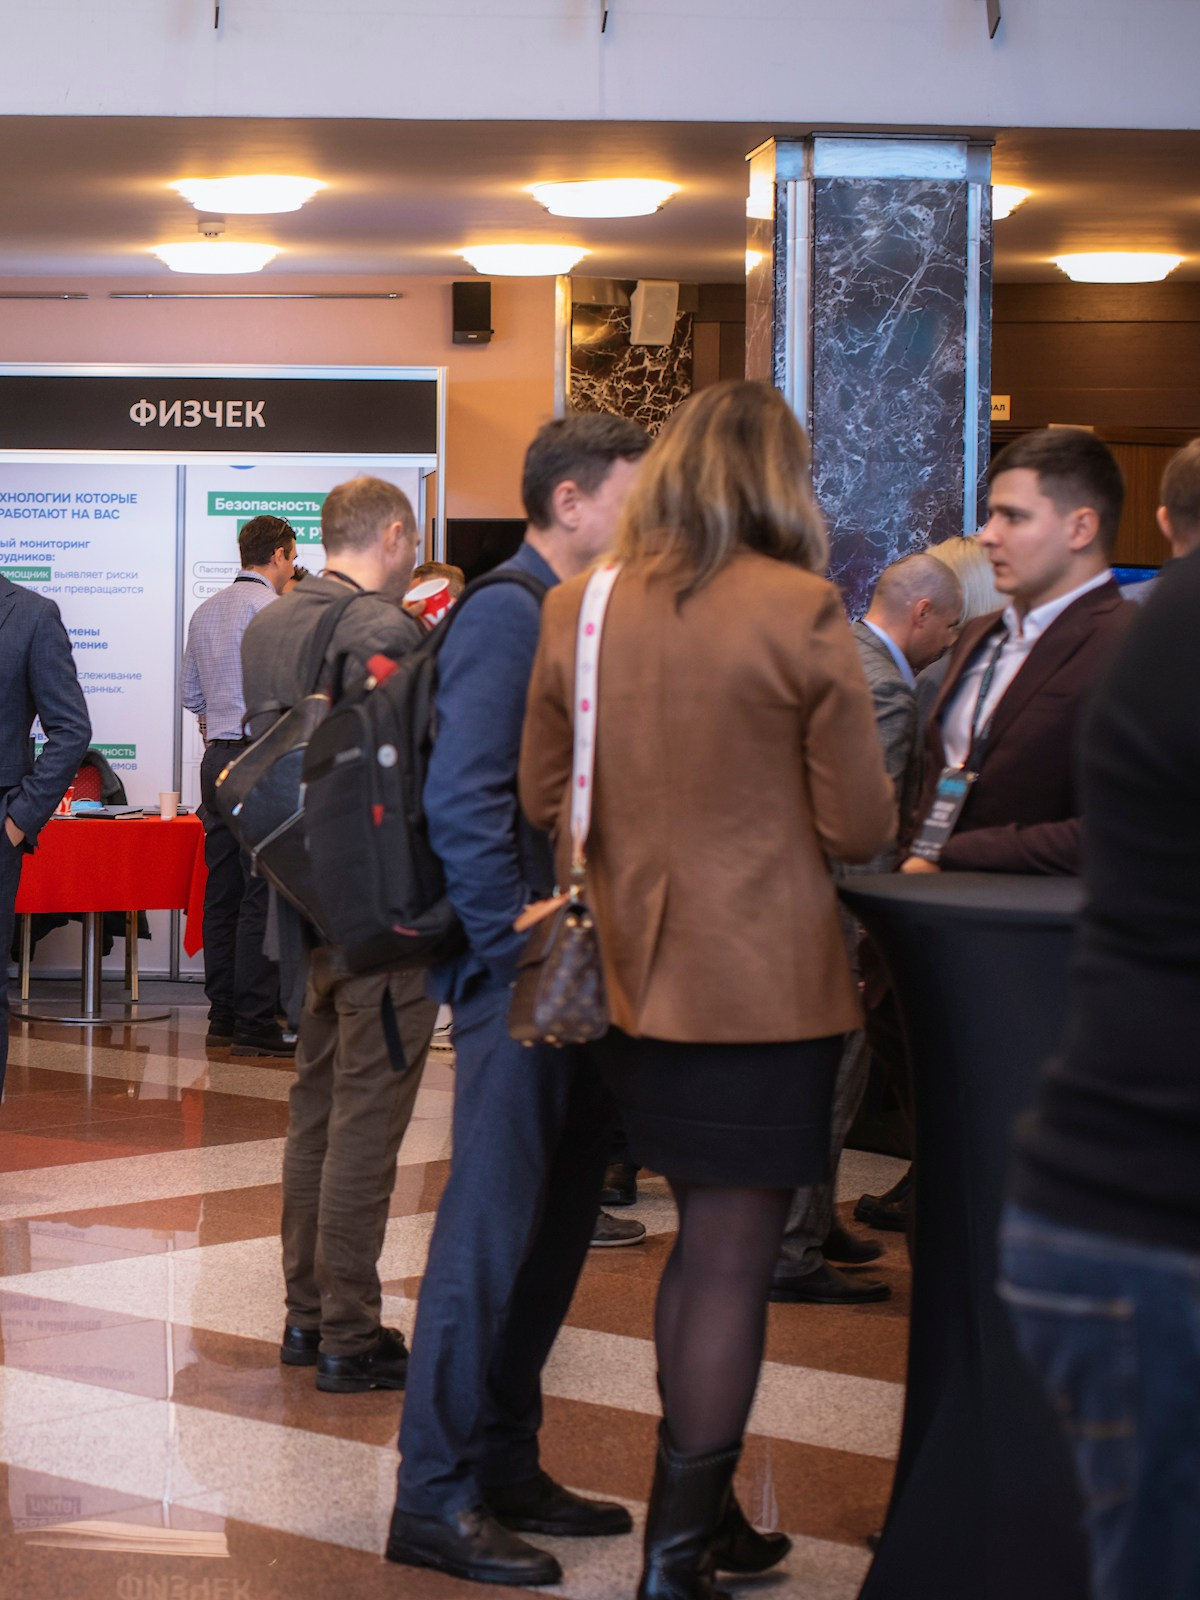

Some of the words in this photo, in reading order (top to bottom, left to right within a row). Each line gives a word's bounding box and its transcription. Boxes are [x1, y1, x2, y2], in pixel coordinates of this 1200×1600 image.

[129, 398, 266, 428] ФИЗЧЕК
[75, 493, 138, 504] КОТОРЫЕ
[214, 497, 321, 512] Безопасность
[71, 509, 90, 519] НА
[94, 509, 120, 520] ВАС
[19, 540, 91, 550] мониторинг
[199, 565, 234, 574] Паспорт
[0, 570, 49, 580] омощник
[54, 570, 103, 580] выявляет
[106, 570, 139, 581] риски
[42, 585, 62, 594] они
[65, 585, 144, 596] превращаются
[67, 627, 100, 637] мены
[71, 641, 109, 650] ление
[77, 671, 143, 681] слеживание
[83, 685, 125, 695] данных.
[111, 762, 138, 771] емов
